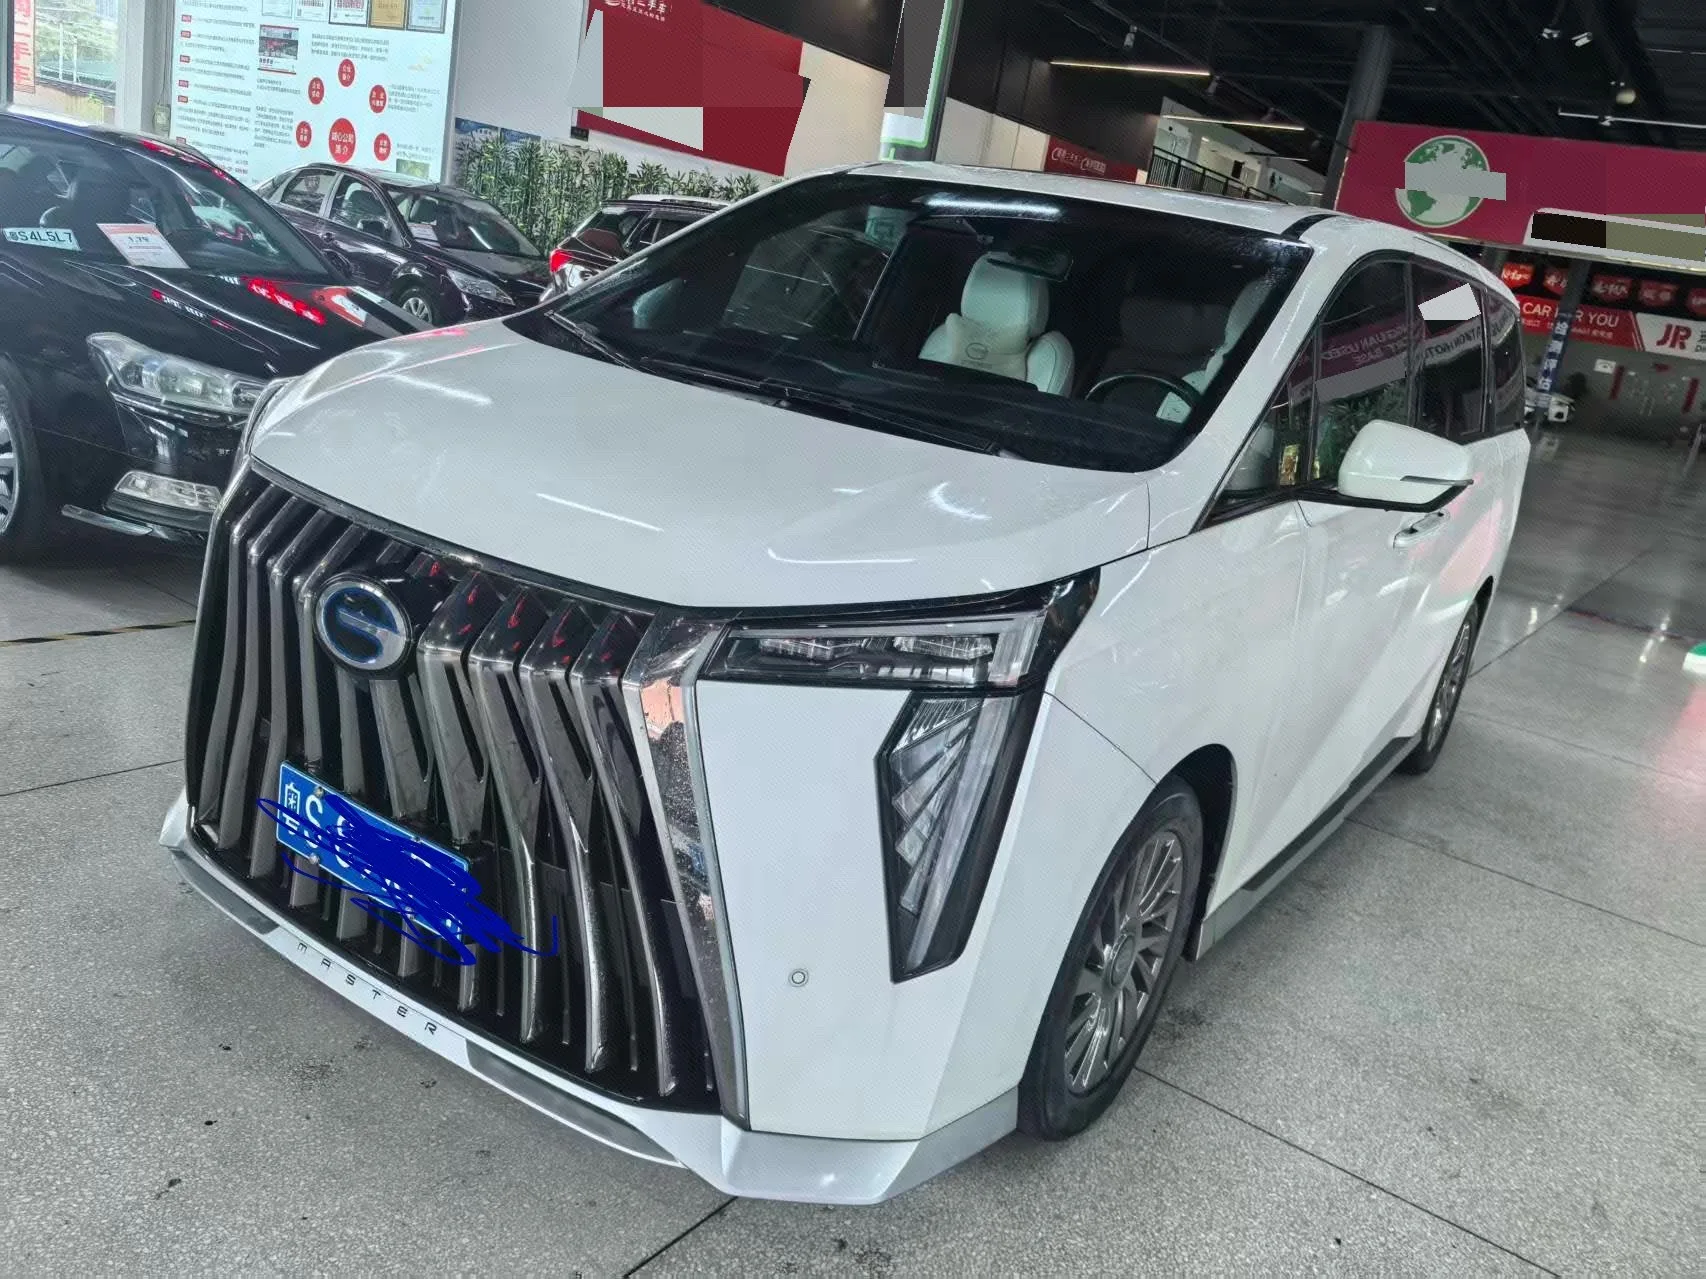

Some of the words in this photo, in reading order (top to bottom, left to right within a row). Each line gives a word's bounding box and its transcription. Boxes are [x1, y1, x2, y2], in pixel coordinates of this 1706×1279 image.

[1522, 302, 1552, 317] CAR
[1588, 311, 1620, 328] YOU
[1656, 323, 1692, 350] JR
[298, 942, 437, 1035] MASTER
